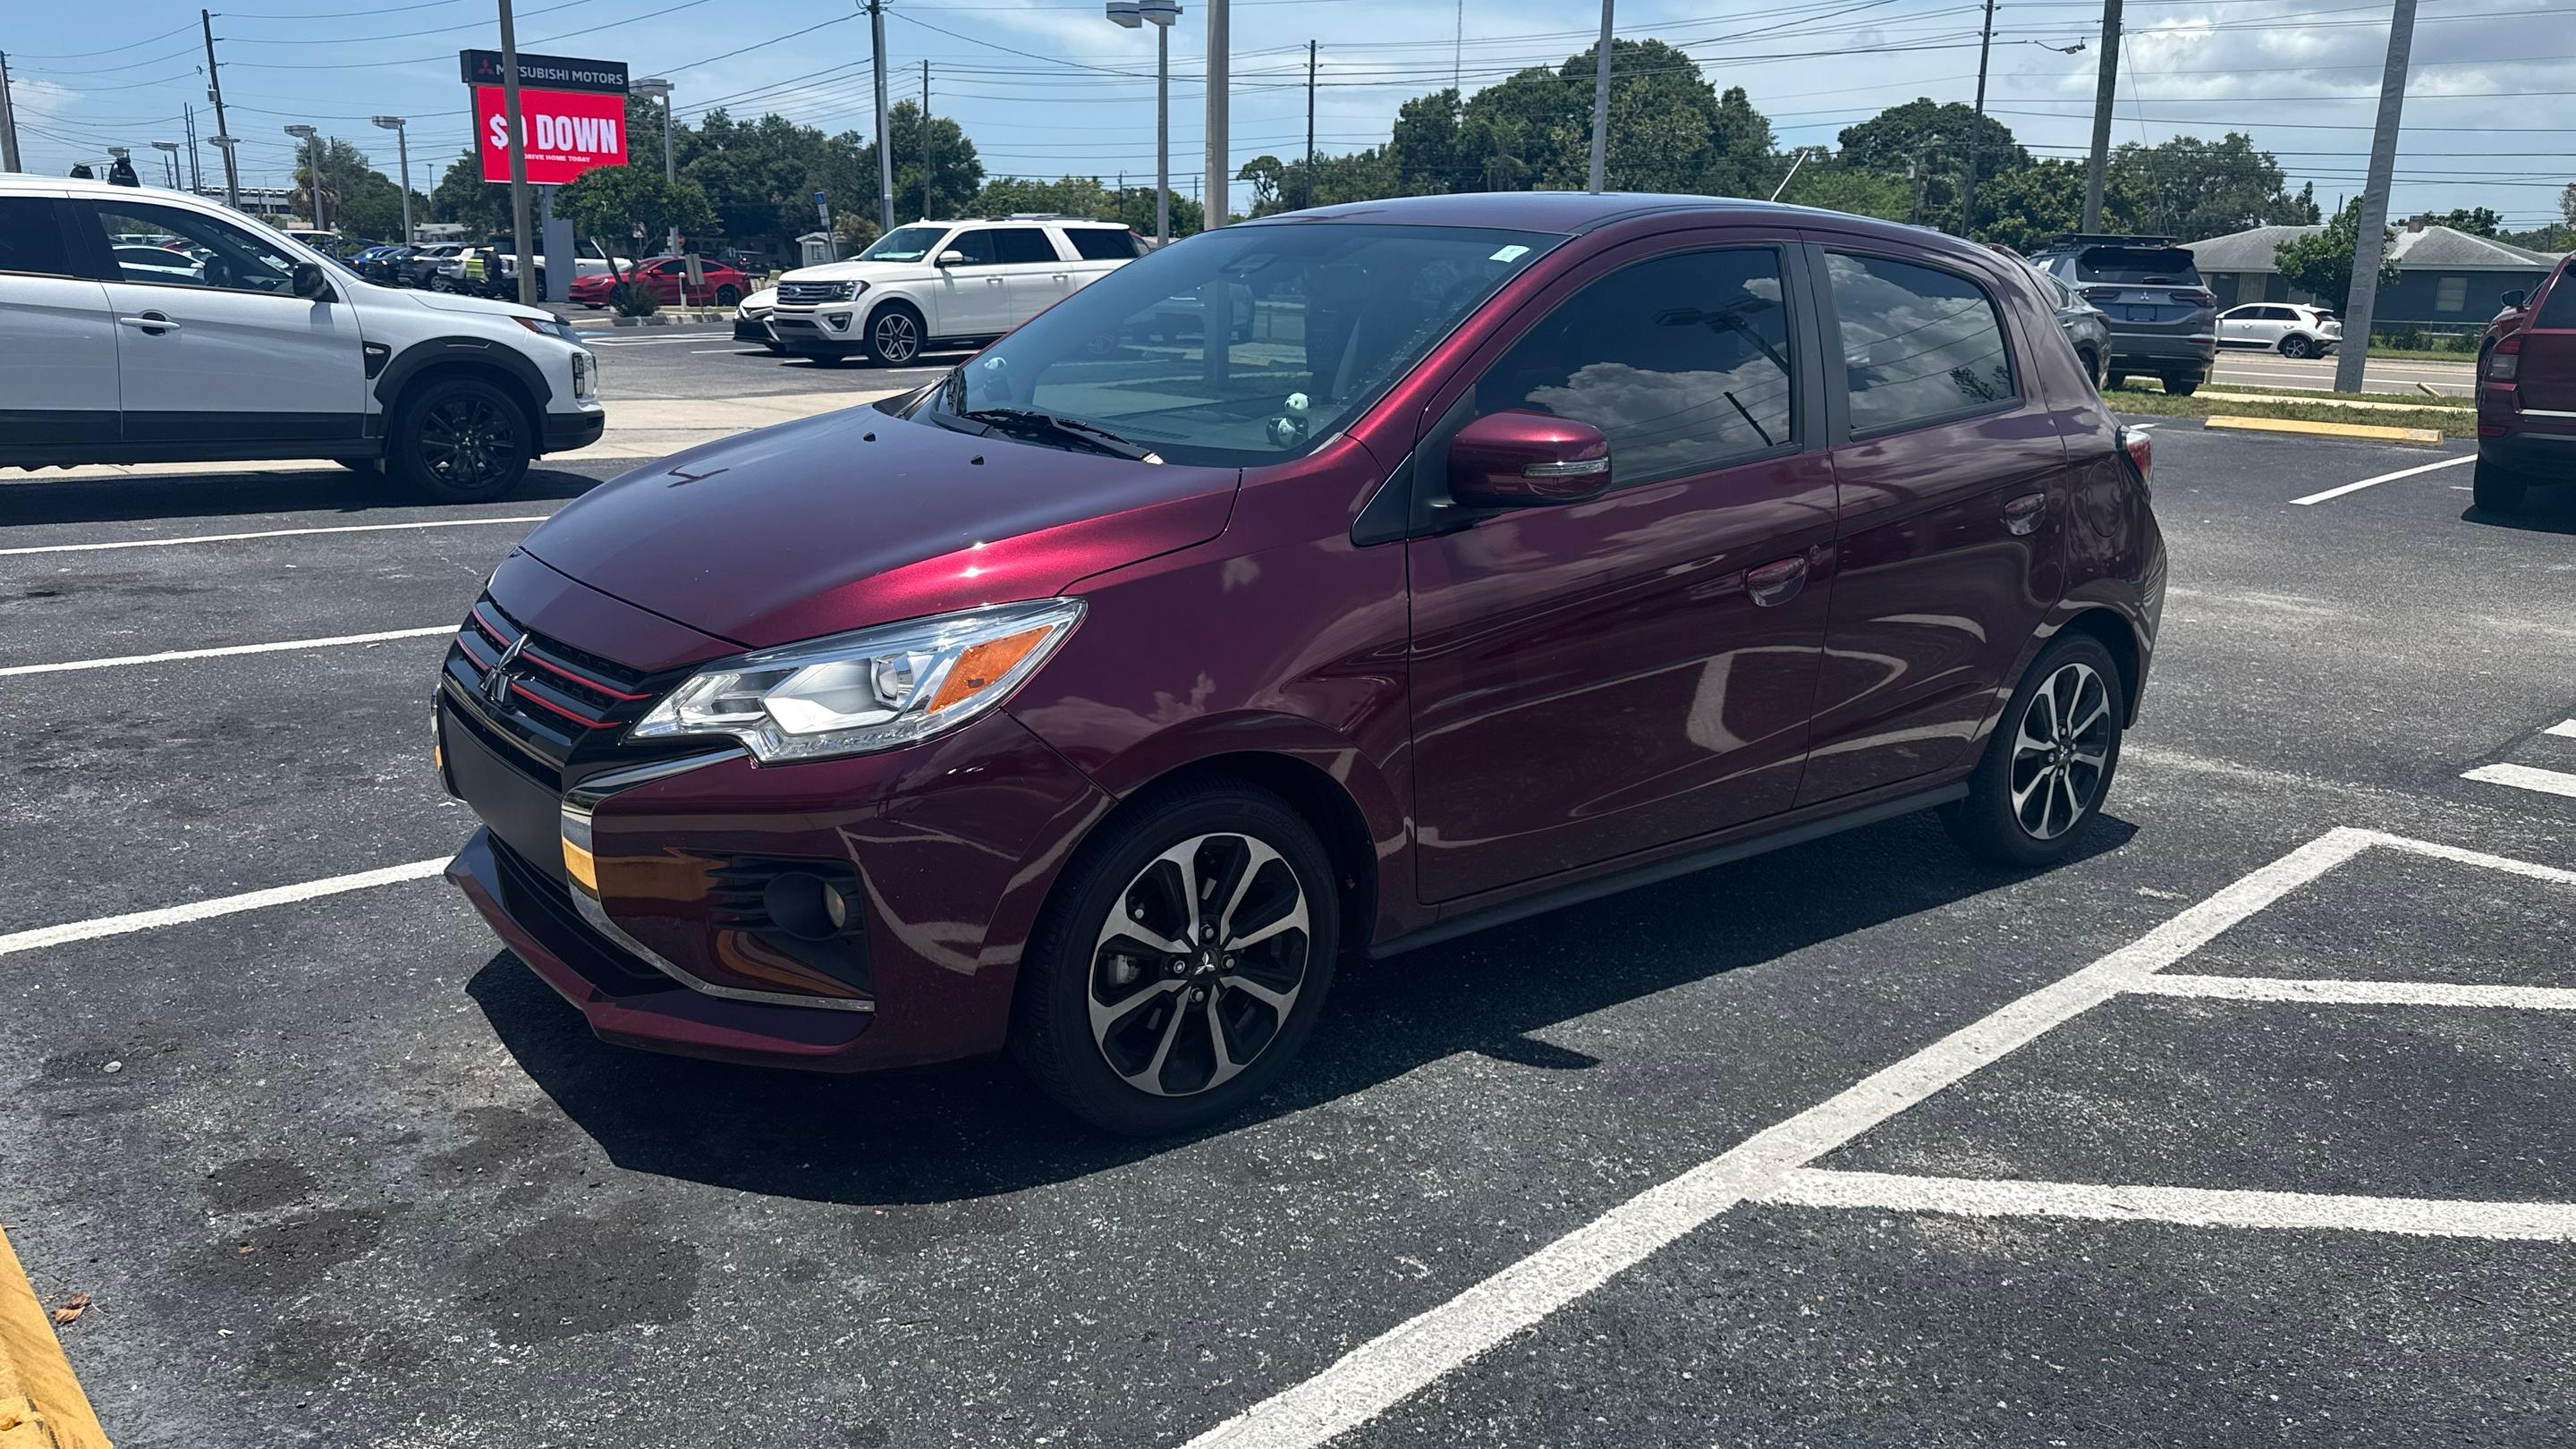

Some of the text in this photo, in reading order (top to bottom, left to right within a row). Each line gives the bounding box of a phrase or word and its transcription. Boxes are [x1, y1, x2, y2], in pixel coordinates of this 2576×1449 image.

[496, 64, 623, 85] MSUBISHI MOTORS
[536, 114, 618, 154] DOWN
